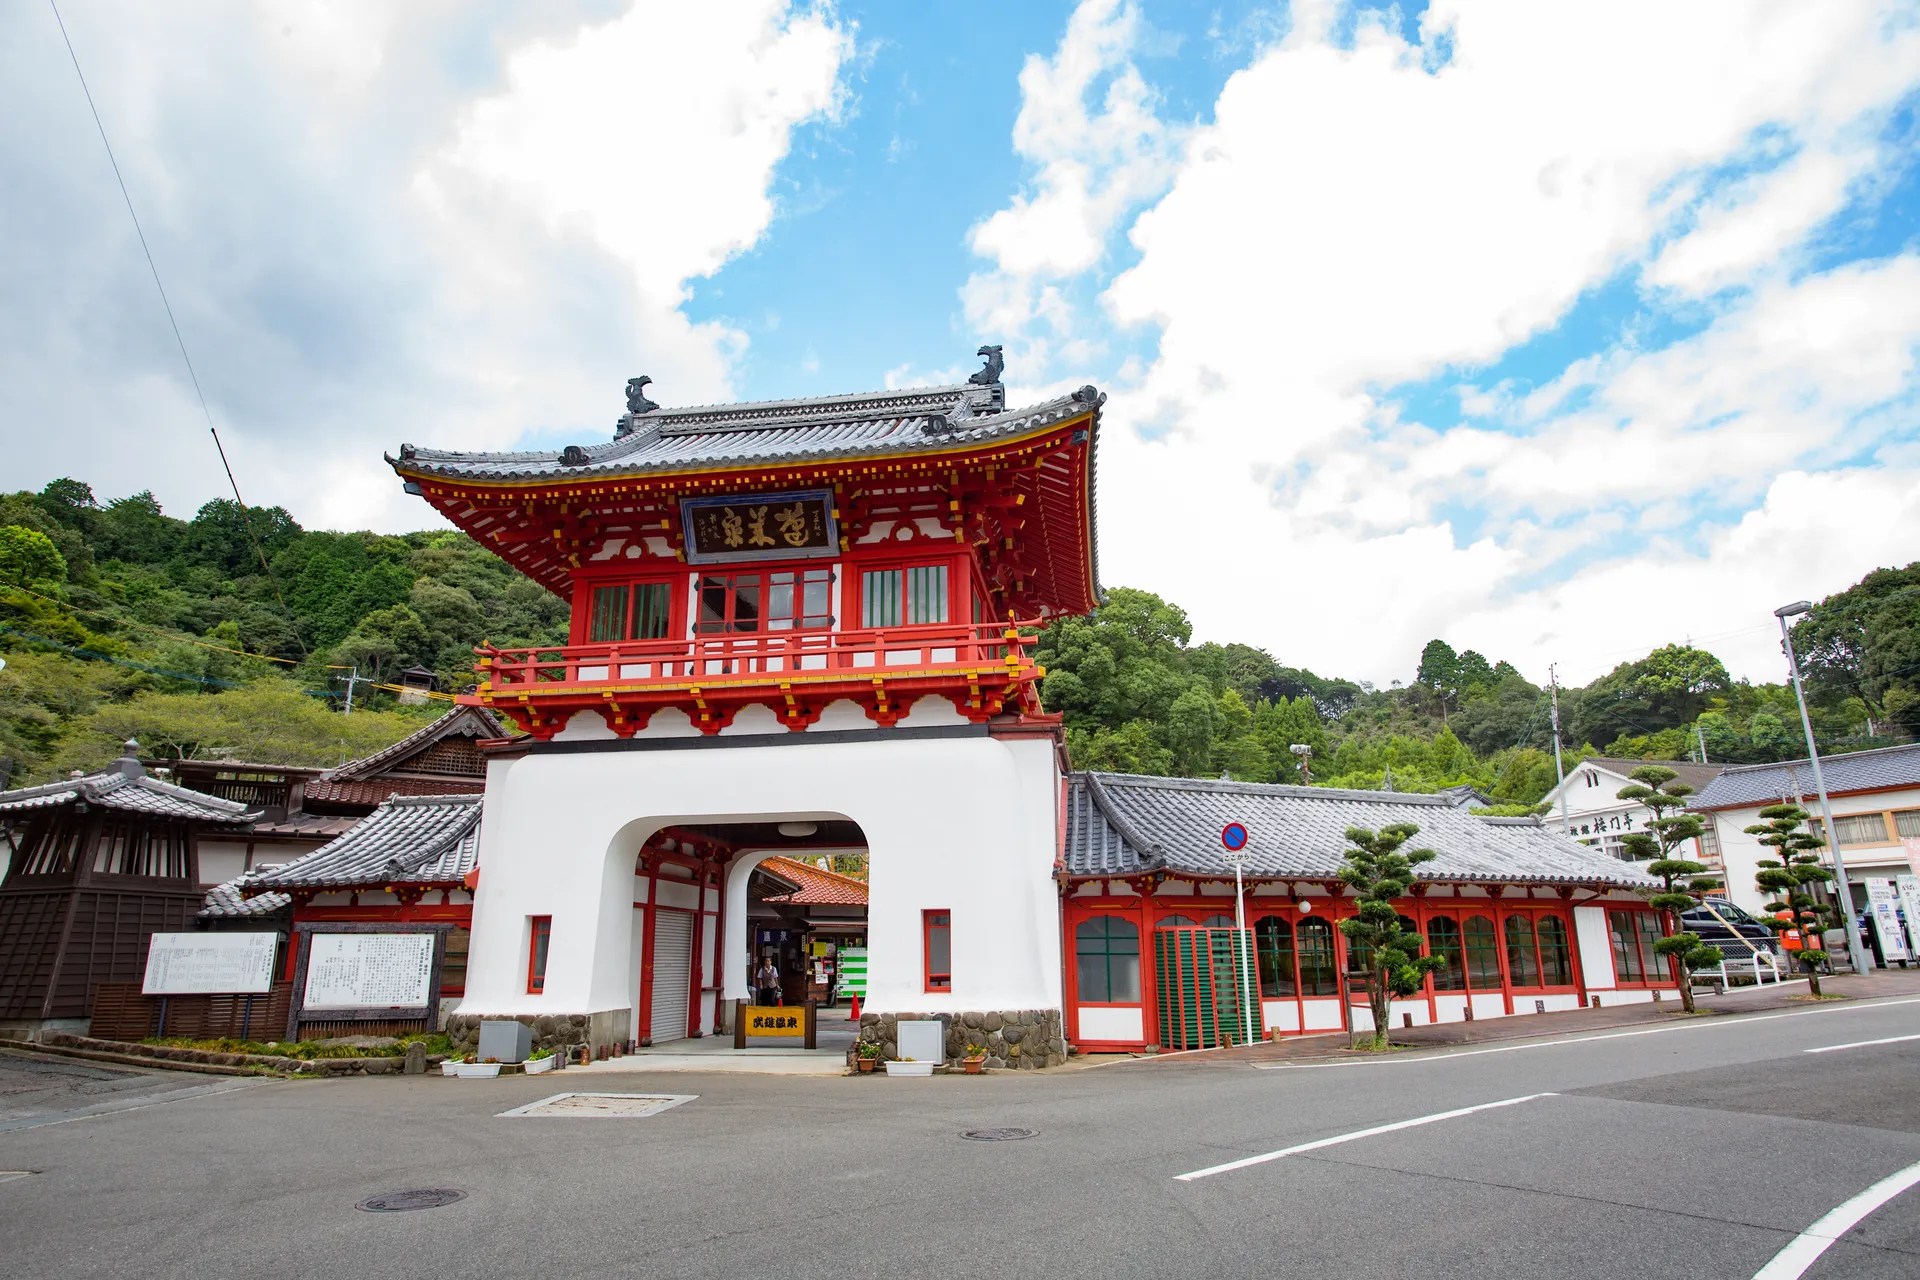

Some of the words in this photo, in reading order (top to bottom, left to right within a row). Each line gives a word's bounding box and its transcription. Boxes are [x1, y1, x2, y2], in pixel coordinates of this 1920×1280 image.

[1224, 853, 1250, 862] ここから
[753, 1016, 798, 1029] 武雄温泉
